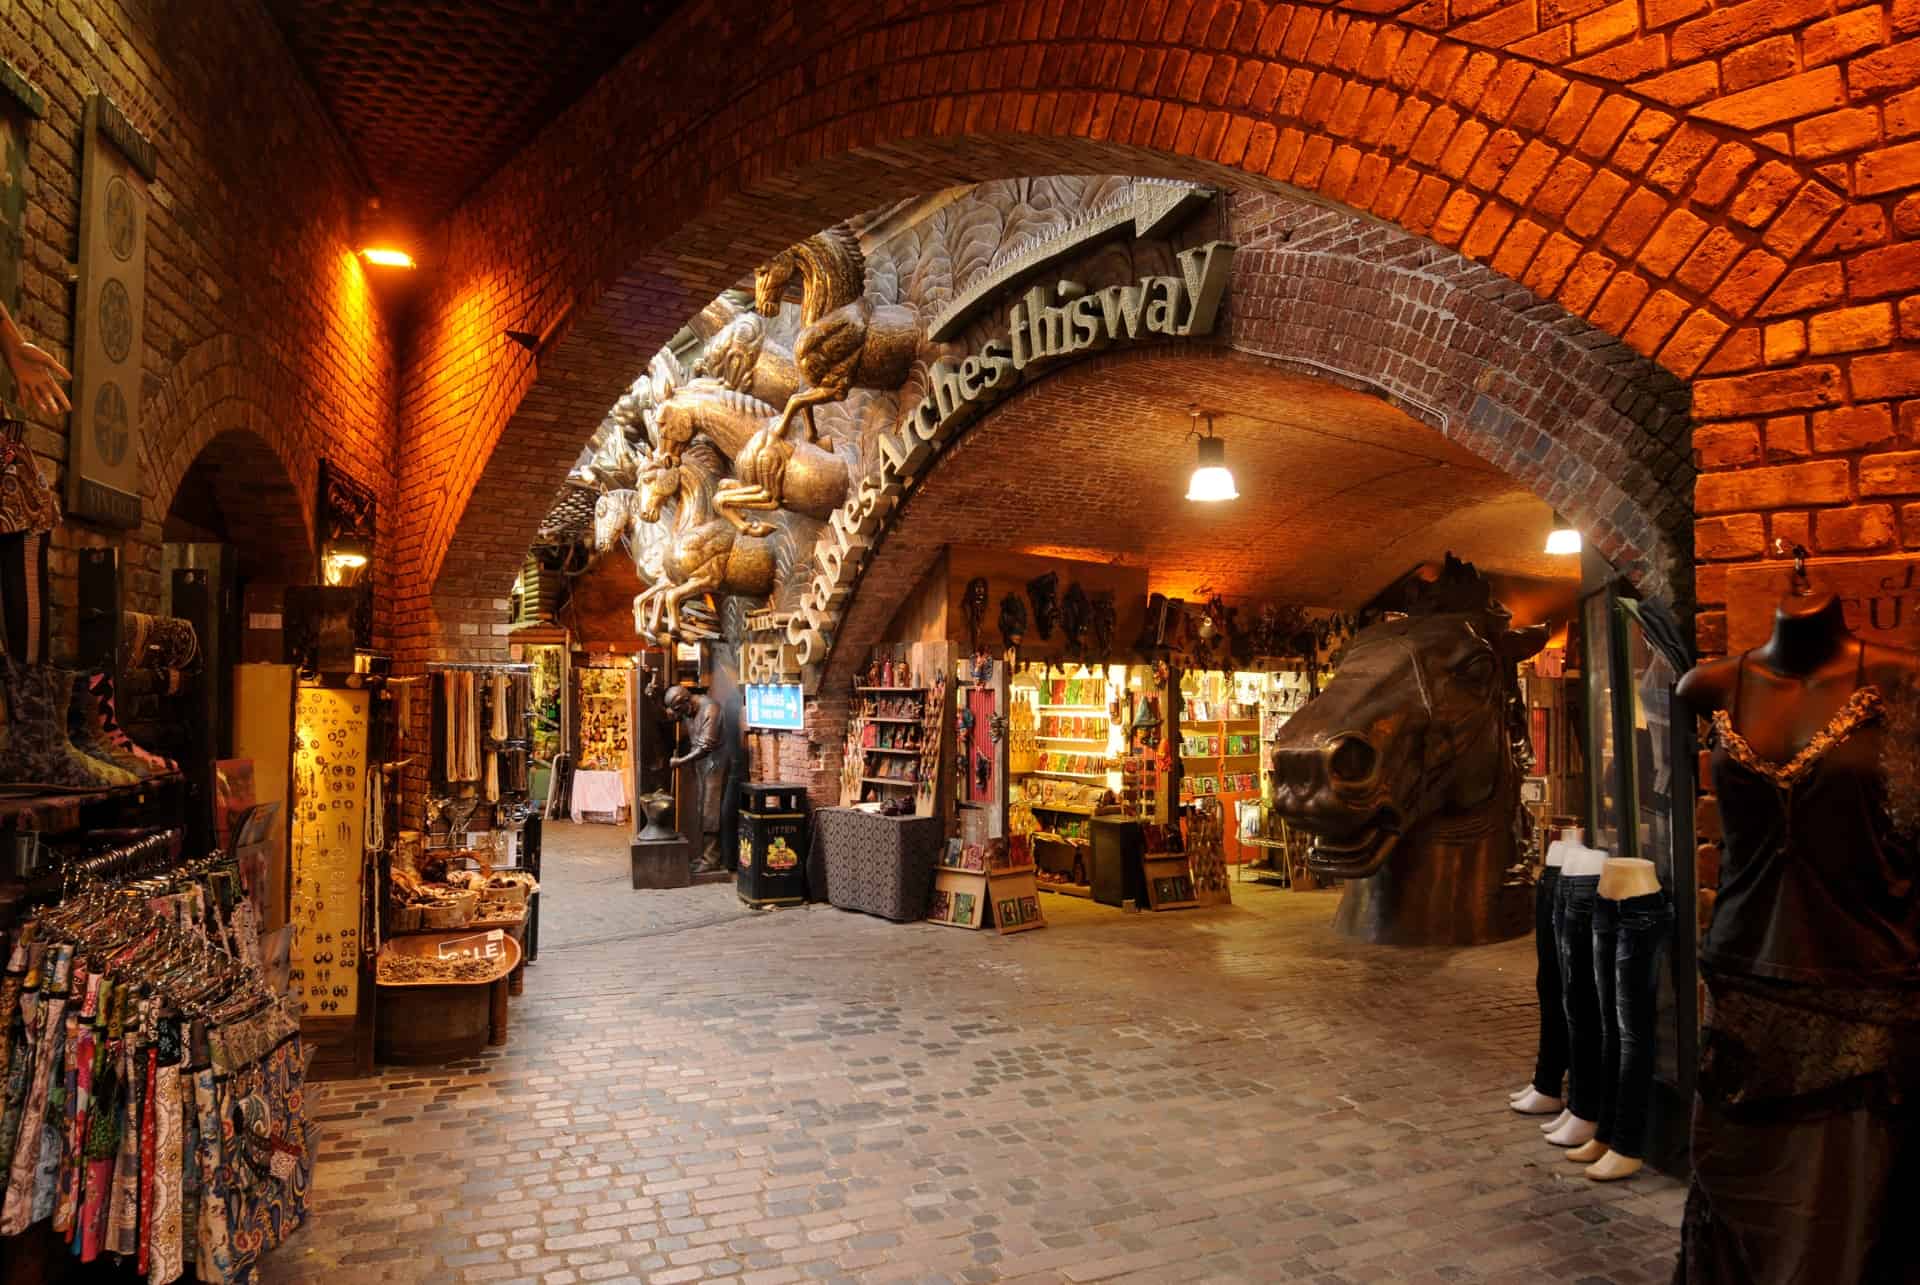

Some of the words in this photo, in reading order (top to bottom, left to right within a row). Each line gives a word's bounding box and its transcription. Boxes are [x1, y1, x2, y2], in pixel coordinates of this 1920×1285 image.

[786, 474, 882, 666] Stables
[876, 338, 1006, 498] Arches
[1007, 279, 1100, 370] this
[1096, 240, 1236, 340] way
[737, 640, 790, 684] 1854
